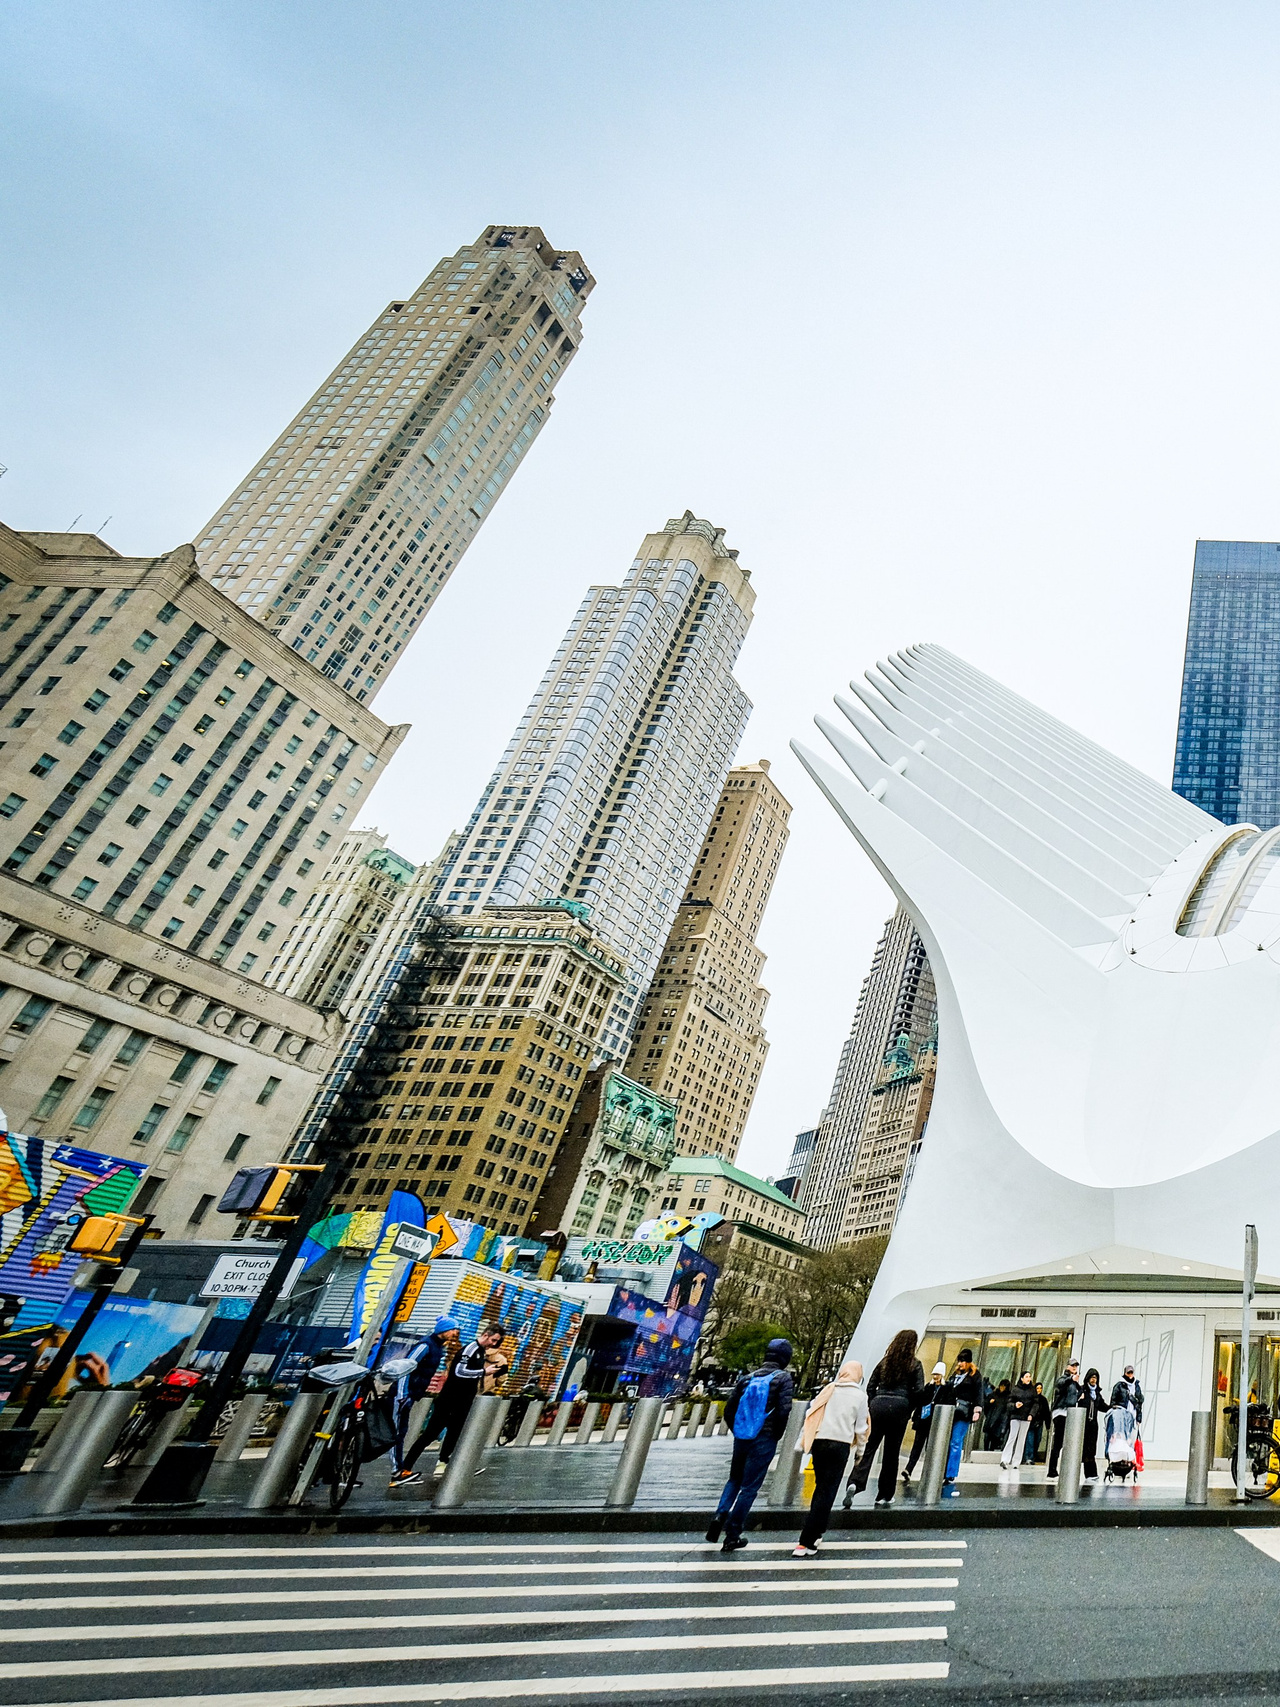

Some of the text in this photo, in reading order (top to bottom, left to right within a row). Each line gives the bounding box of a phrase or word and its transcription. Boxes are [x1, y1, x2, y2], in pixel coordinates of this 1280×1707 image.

[235, 1259, 271, 1268] Church
[224, 1272, 271, 1281] EXIT CLOS
